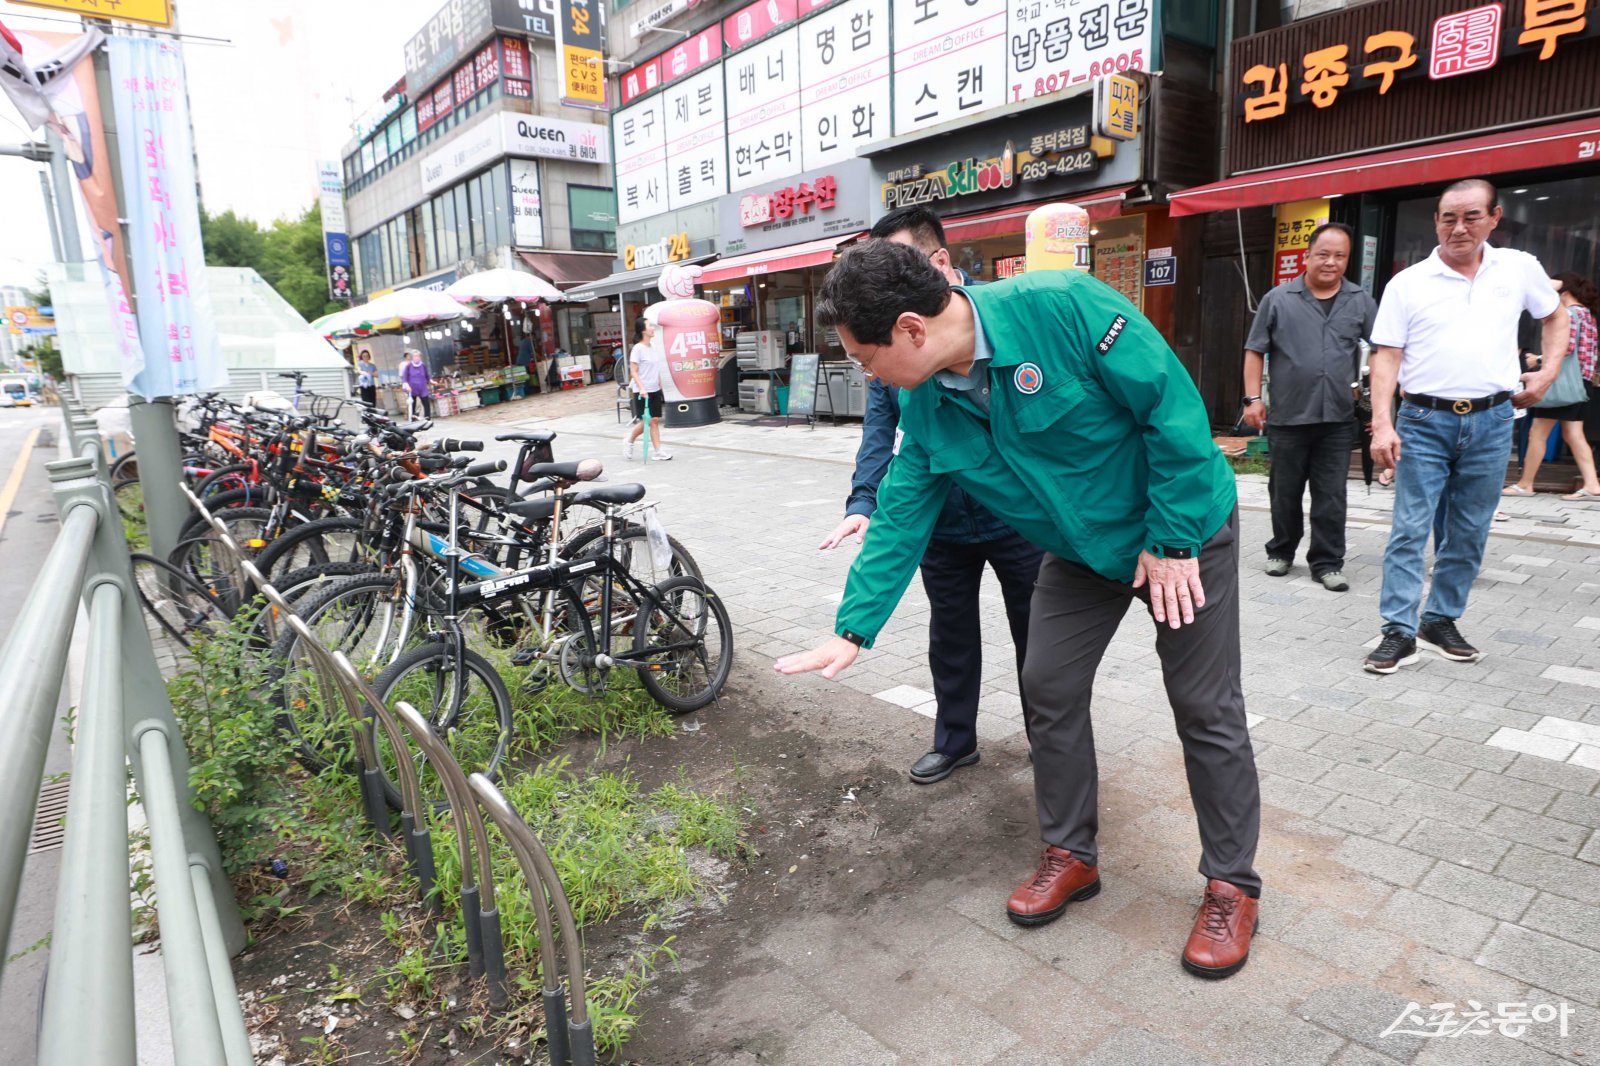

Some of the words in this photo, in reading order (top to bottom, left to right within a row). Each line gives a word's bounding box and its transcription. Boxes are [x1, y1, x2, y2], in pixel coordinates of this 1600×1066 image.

[522, 14, 551, 34] TEL
[816, 9, 873, 65] 명함
[1012, 17, 1073, 73] 납품
[1079, 0, 1148, 51] 전문
[913, 44, 942, 62] DREAM
[954, 27, 985, 46] OFFICE
[739, 49, 784, 95] 배너
[1243, 31, 1418, 123] 김종구
[675, 84, 712, 123] 제본
[914, 65, 983, 122] 스캔
[1111, 80, 1135, 108] 피자
[623, 109, 654, 146] 문구
[818, 103, 875, 152] 인화
[1111, 108, 1134, 132] 스쿨
[580, 145, 597, 159] 헤어
[735, 131, 792, 177] 현수막
[1030, 125, 1086, 155] 풍덕천점
[678, 158, 714, 196] 출력
[1022, 151, 1091, 181] 263-4242
[627, 178, 658, 208] 복사
[885, 175, 945, 209] PIZZA
[1279, 219, 1315, 233] 김종구
[1150, 266, 1171, 279] 107
